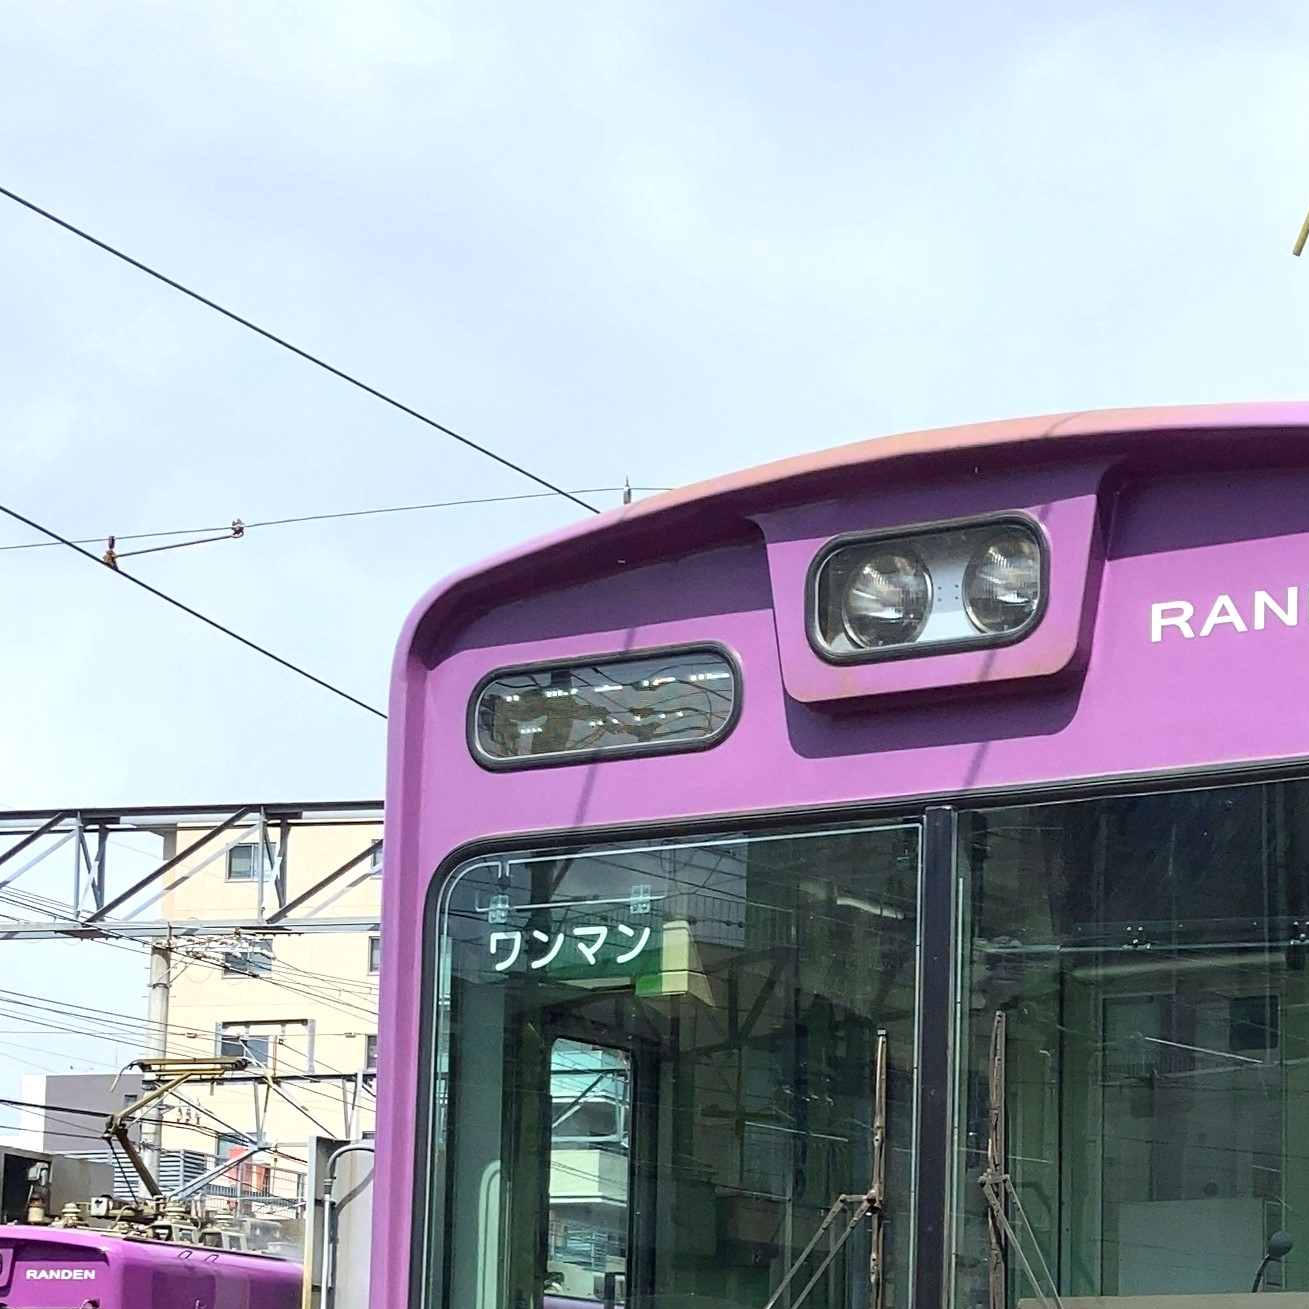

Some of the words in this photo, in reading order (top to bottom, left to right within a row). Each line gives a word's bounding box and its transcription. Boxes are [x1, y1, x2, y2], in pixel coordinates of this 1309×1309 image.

[490, 924, 651, 972] ワンマン
[25, 1269, 96, 1280] RANDEN
